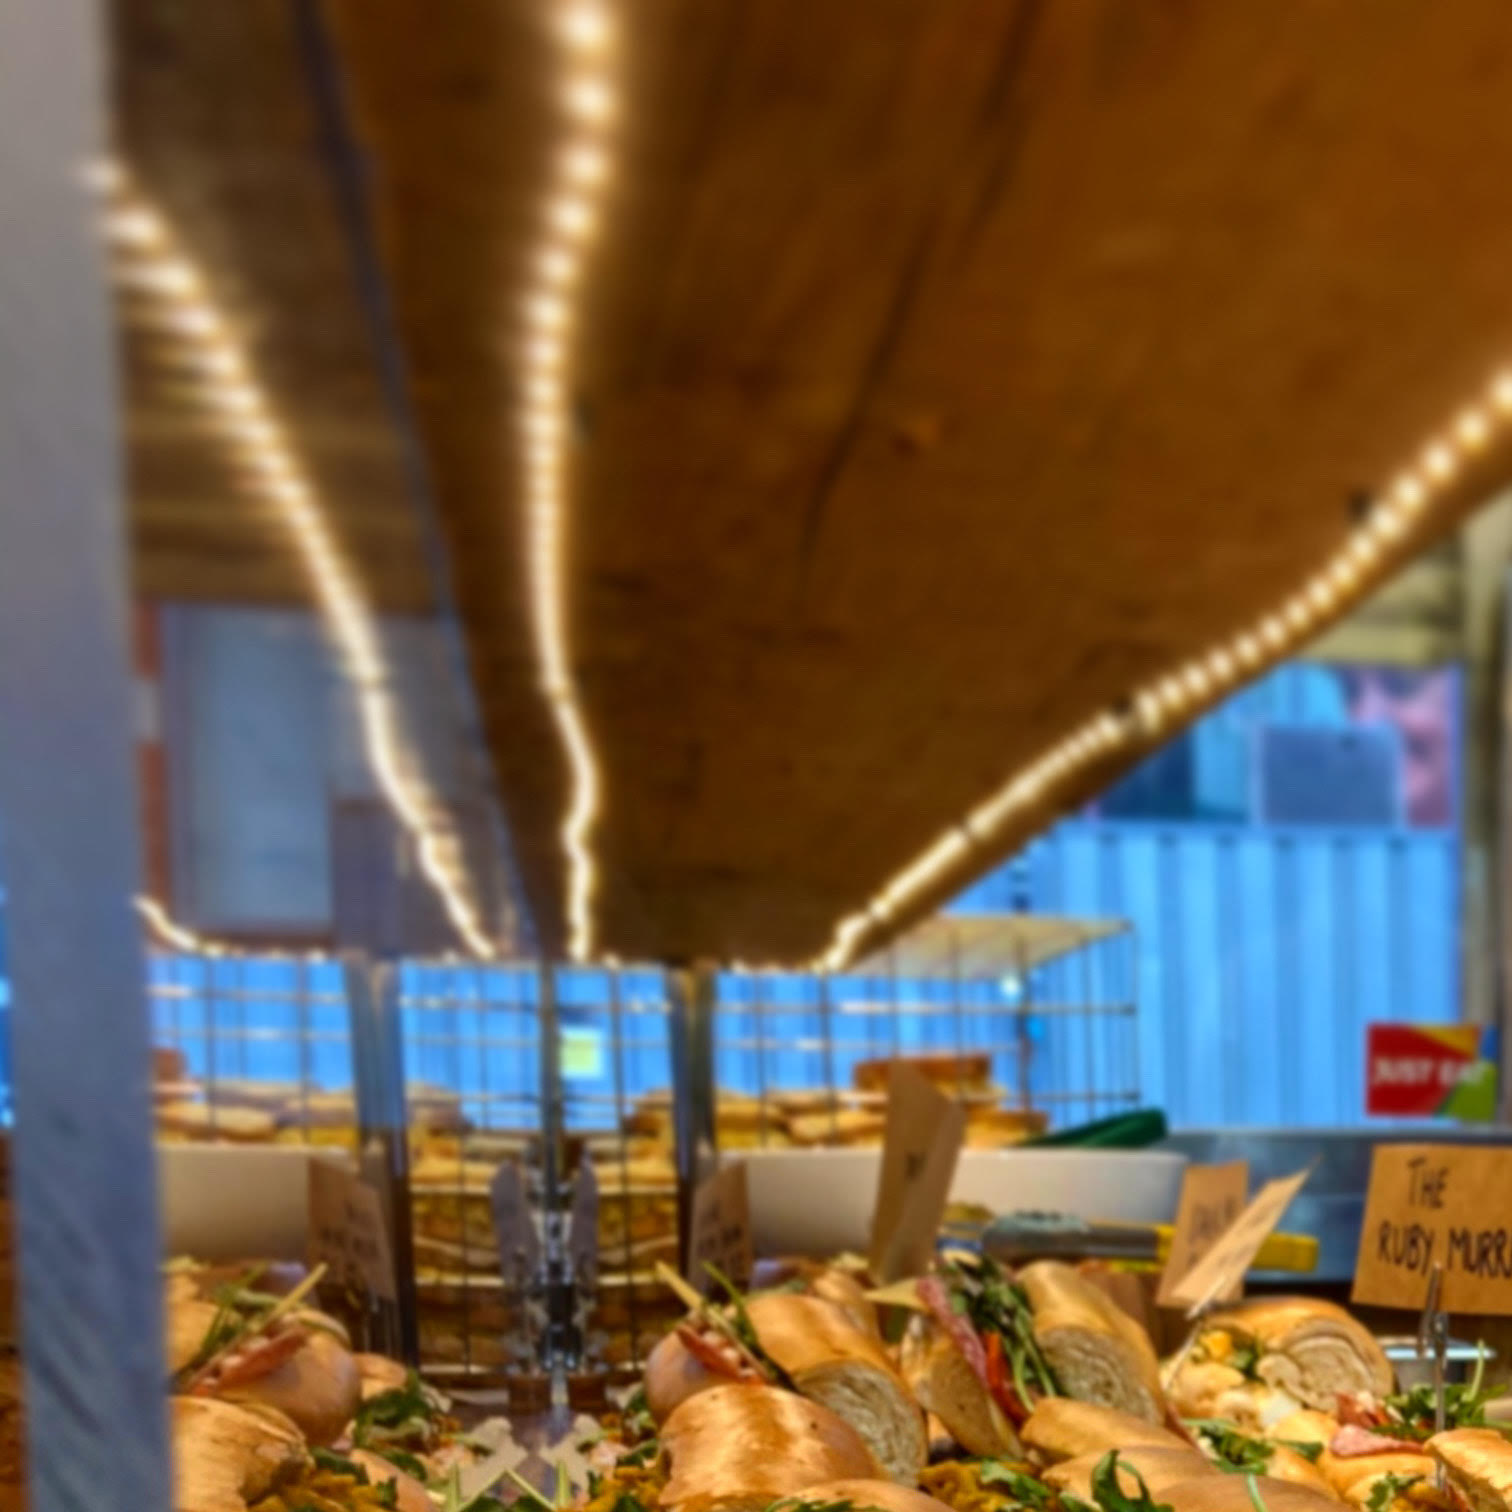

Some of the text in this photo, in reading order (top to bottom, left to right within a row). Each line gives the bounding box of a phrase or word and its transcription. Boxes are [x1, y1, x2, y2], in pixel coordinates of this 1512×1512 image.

[1373, 1058, 1432, 1083] JUST
[1407, 1156, 1449, 1209] THE
[1378, 1219, 1435, 1277] RUBY
